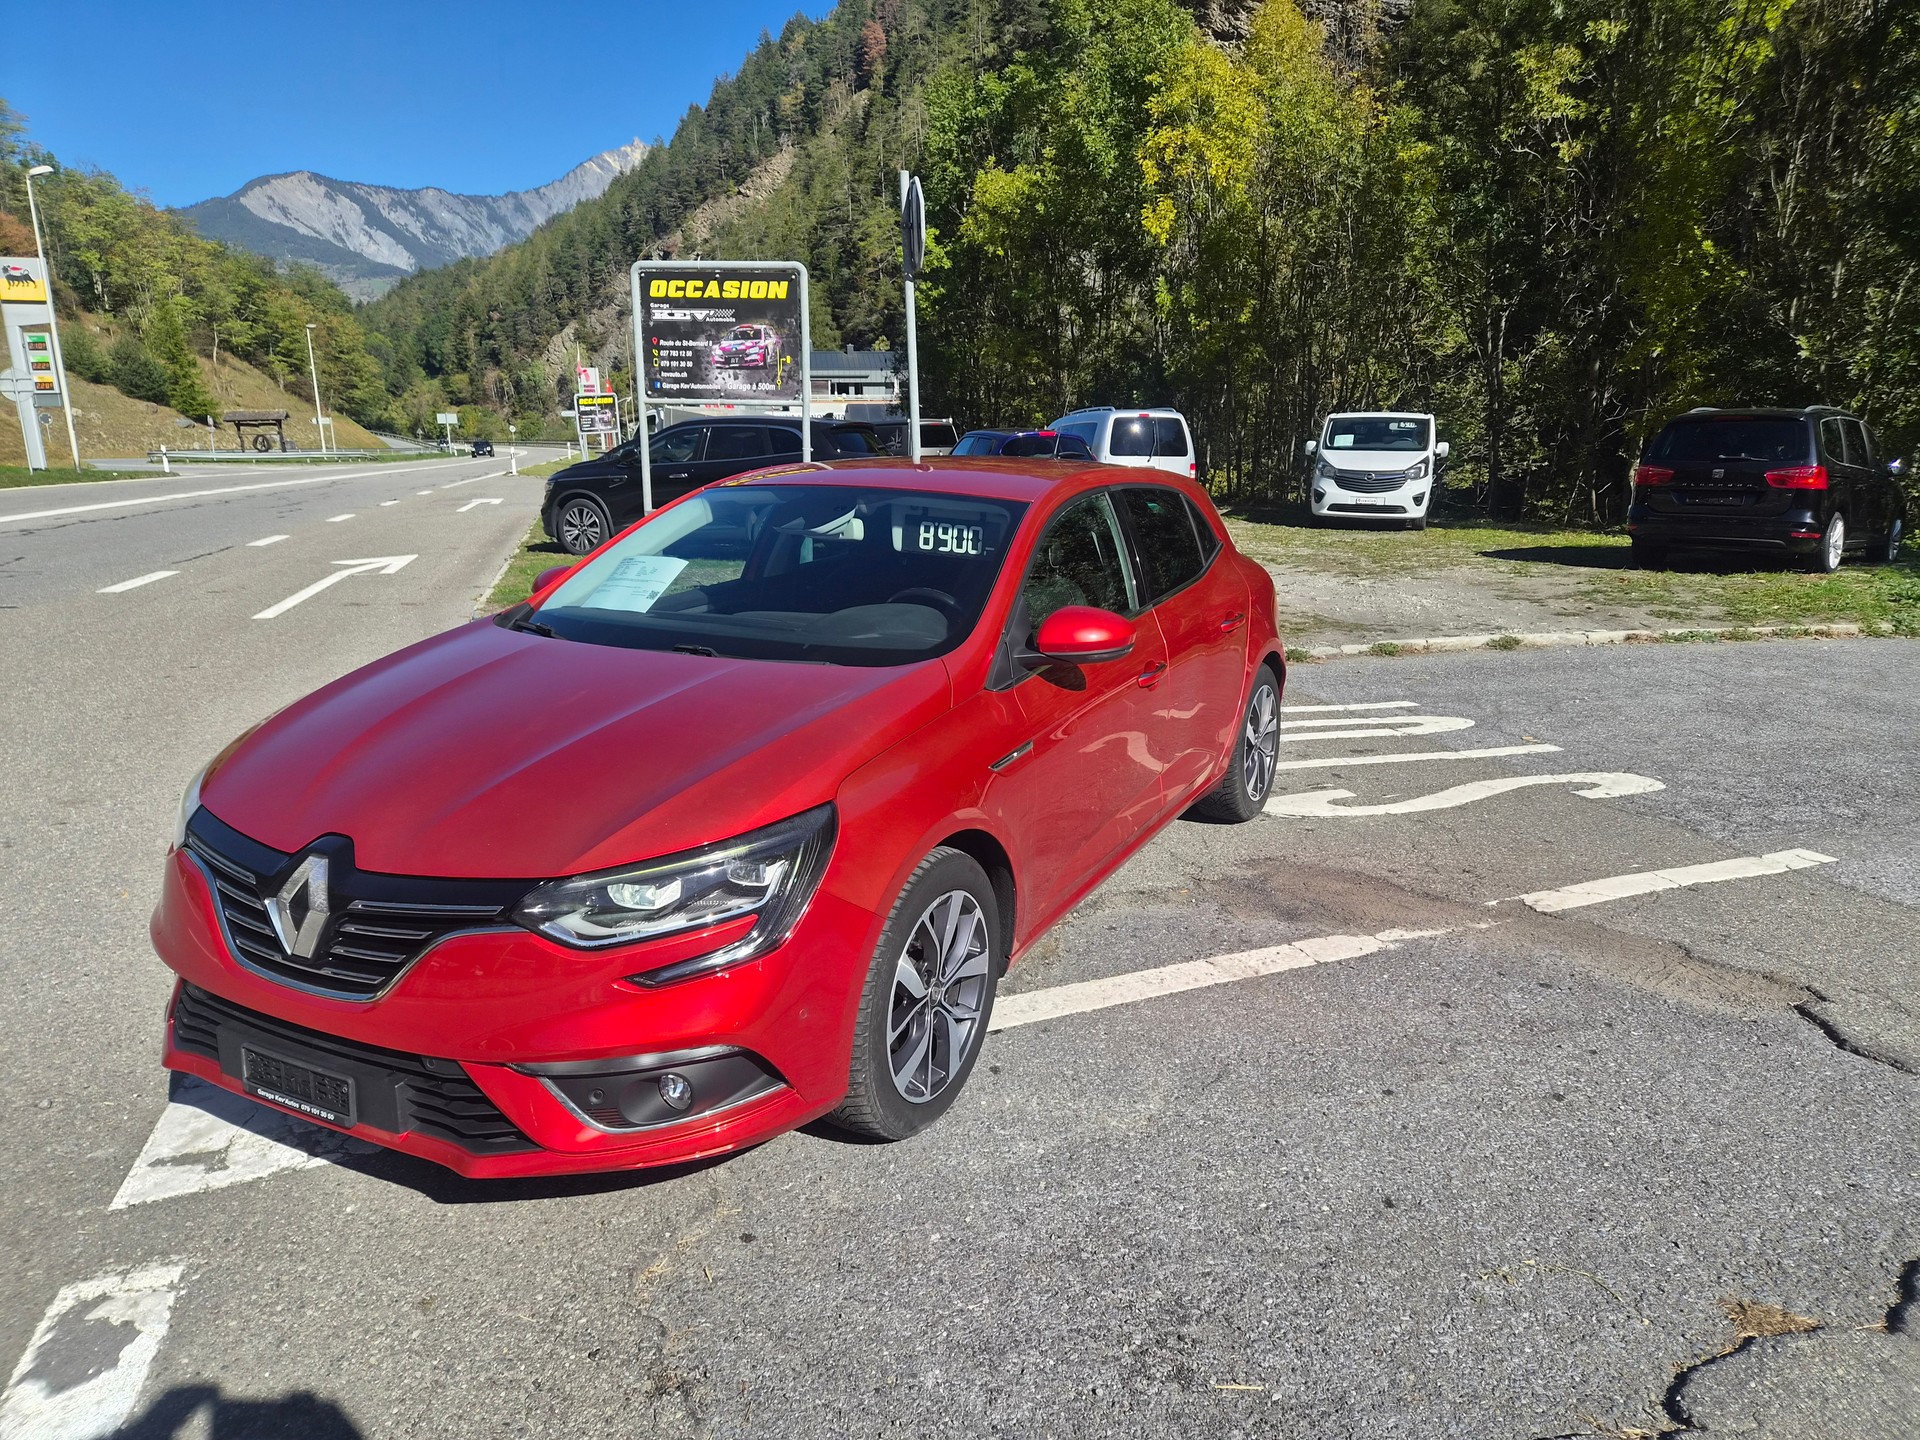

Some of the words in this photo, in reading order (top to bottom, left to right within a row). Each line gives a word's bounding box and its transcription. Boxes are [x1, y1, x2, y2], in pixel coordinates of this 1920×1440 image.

[649, 279, 789, 299] OCCASION
[662, 382, 680, 390] Garage
[727, 382, 751, 391] Garage
[757, 383, 776, 391] 500m
[578, 397, 614, 405] OCCASION
[257, 1088, 275, 1100] Garage
[300, 1104, 311, 1113] 079
[310, 1106, 320, 1116] 101
[319, 1110, 327, 1119] 30
